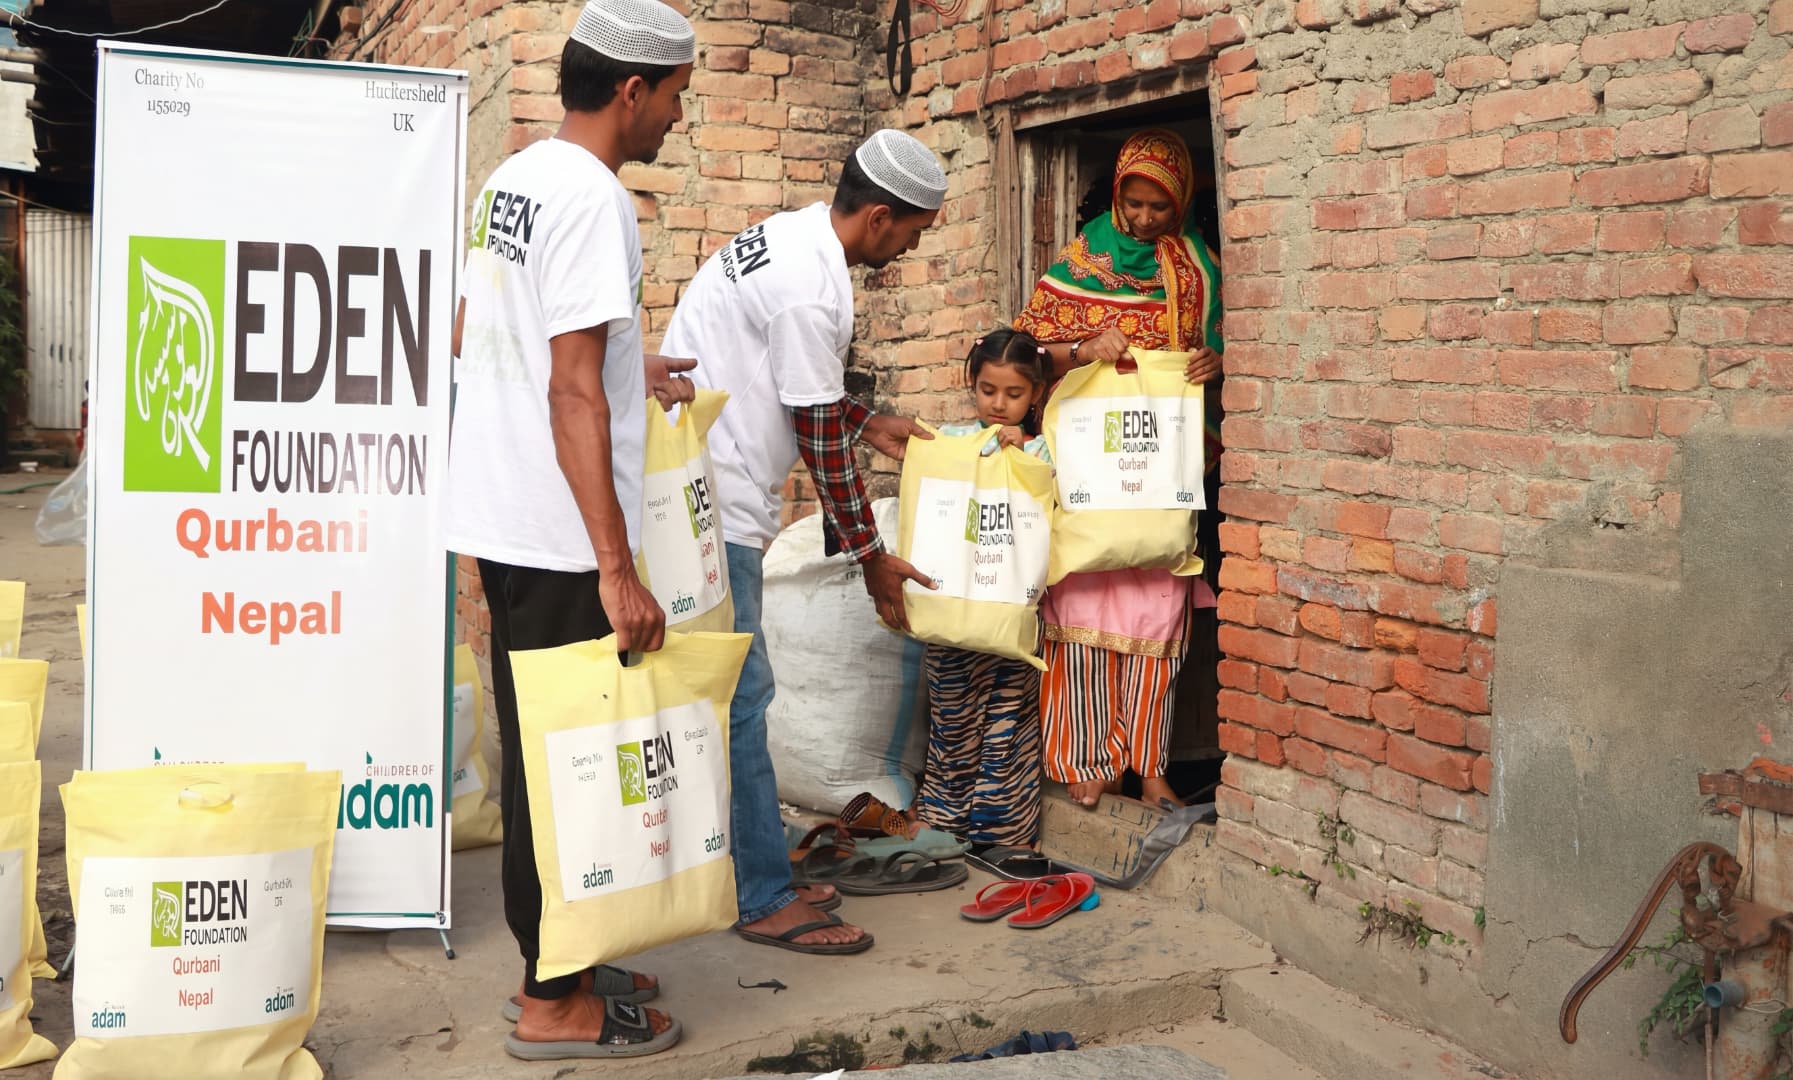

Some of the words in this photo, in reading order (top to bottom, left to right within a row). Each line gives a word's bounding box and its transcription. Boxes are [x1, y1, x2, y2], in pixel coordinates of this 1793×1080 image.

[134, 67, 182, 91] Charity
[186, 71, 205, 89] No
[147, 99, 191, 117] 1155029
[393, 112, 415, 132] UK
[233, 240, 432, 406] EDEN
[1122, 410, 1159, 439] EDEN
[232, 429, 428, 496] FOUNDATION
[1121, 479, 1143, 495] Nepal
[176, 507, 368, 558] Qurbani
[974, 571, 998, 588] Nepal
[201, 590, 342, 646] Nepal
[421, 764, 435, 776] OF
[583, 862, 614, 889] adam
[185, 879, 248, 923] EDEN
[183, 926, 248, 946] FOUNDATION
[172, 954, 221, 976] Qurbani
[178, 987, 214, 1010] Nepal
[91, 1008, 127, 1029] adam
